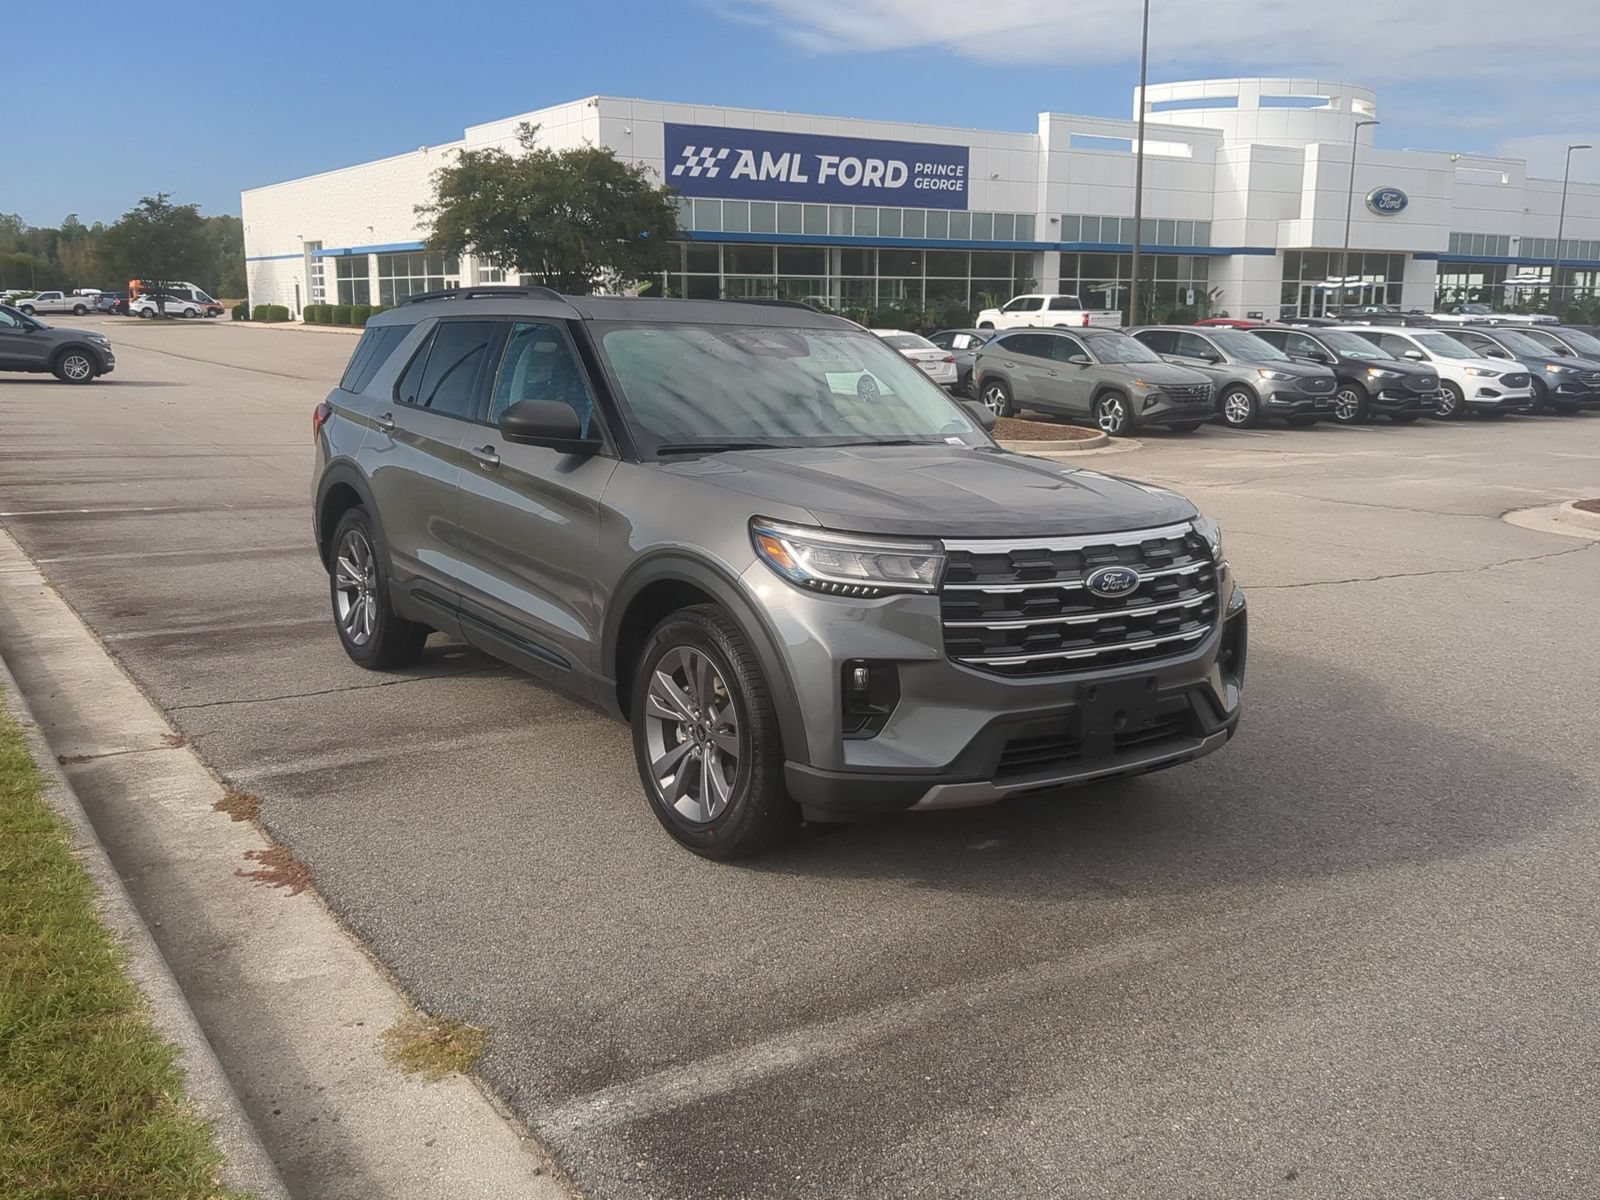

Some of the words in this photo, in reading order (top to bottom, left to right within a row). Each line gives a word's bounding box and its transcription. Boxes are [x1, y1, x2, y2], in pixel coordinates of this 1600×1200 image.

[730, 149, 808, 182] AML
[814, 154, 908, 188] FORD
[914, 163, 964, 177] PRINCE
[914, 178, 963, 191] GEORGE
[1379, 193, 1402, 208] Ford
[1101, 573, 1130, 590] Ford
